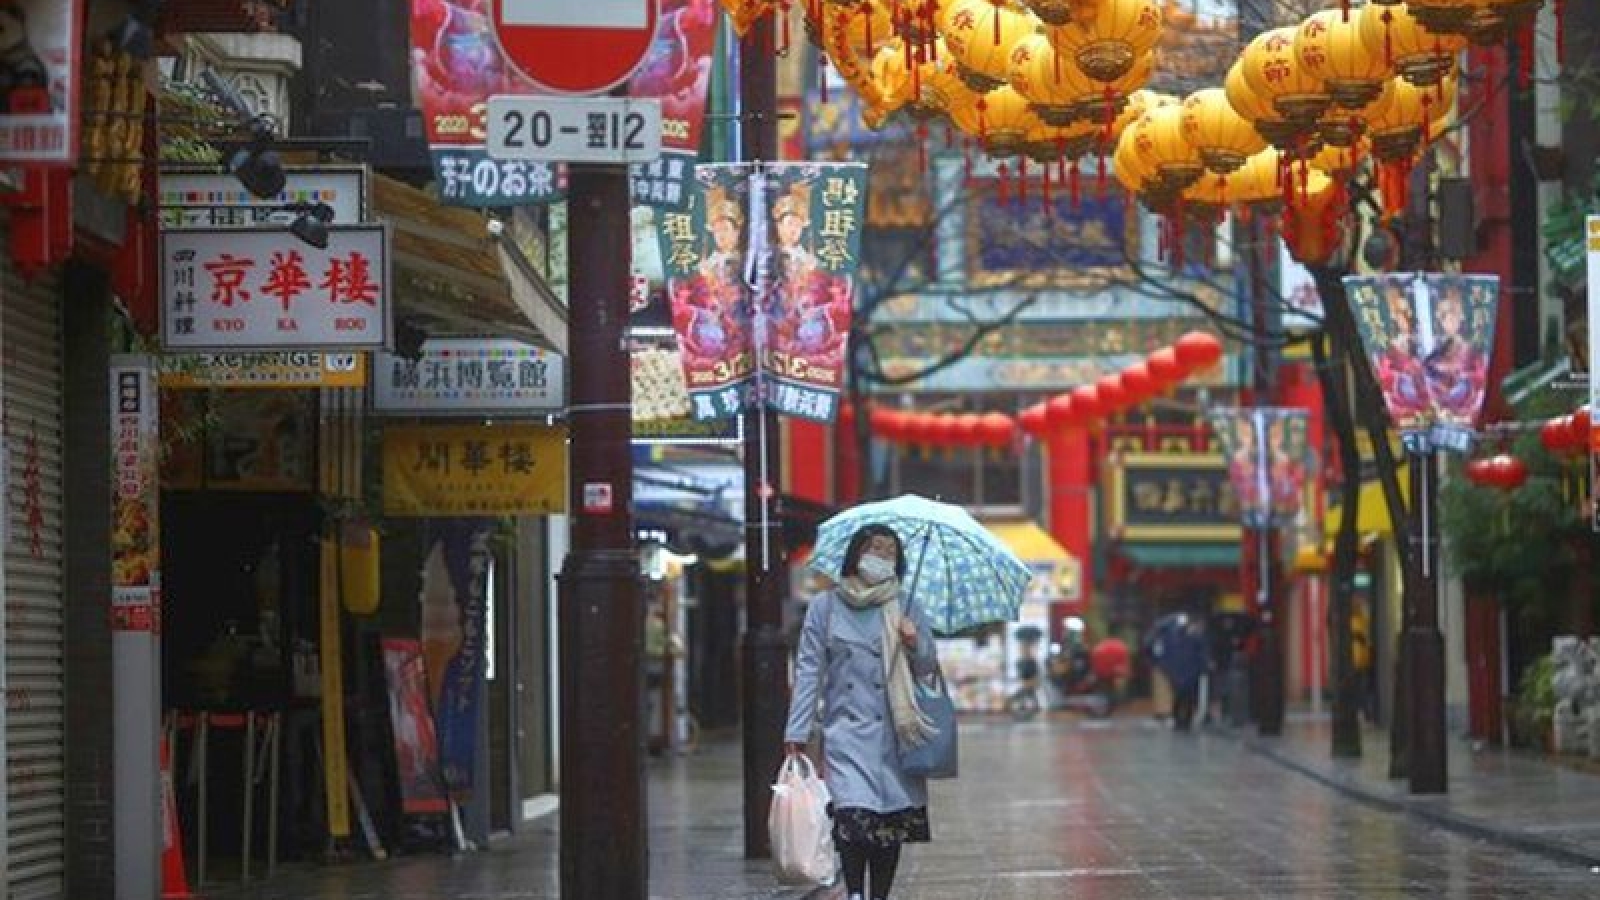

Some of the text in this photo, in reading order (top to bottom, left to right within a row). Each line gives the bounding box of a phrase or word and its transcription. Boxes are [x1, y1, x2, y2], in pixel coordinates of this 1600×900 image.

[172, 249, 197, 335] 四川料理
[203, 250, 380, 311] 京華樓
[213, 317, 246, 332] KYO
[277, 317, 298, 332] KA
